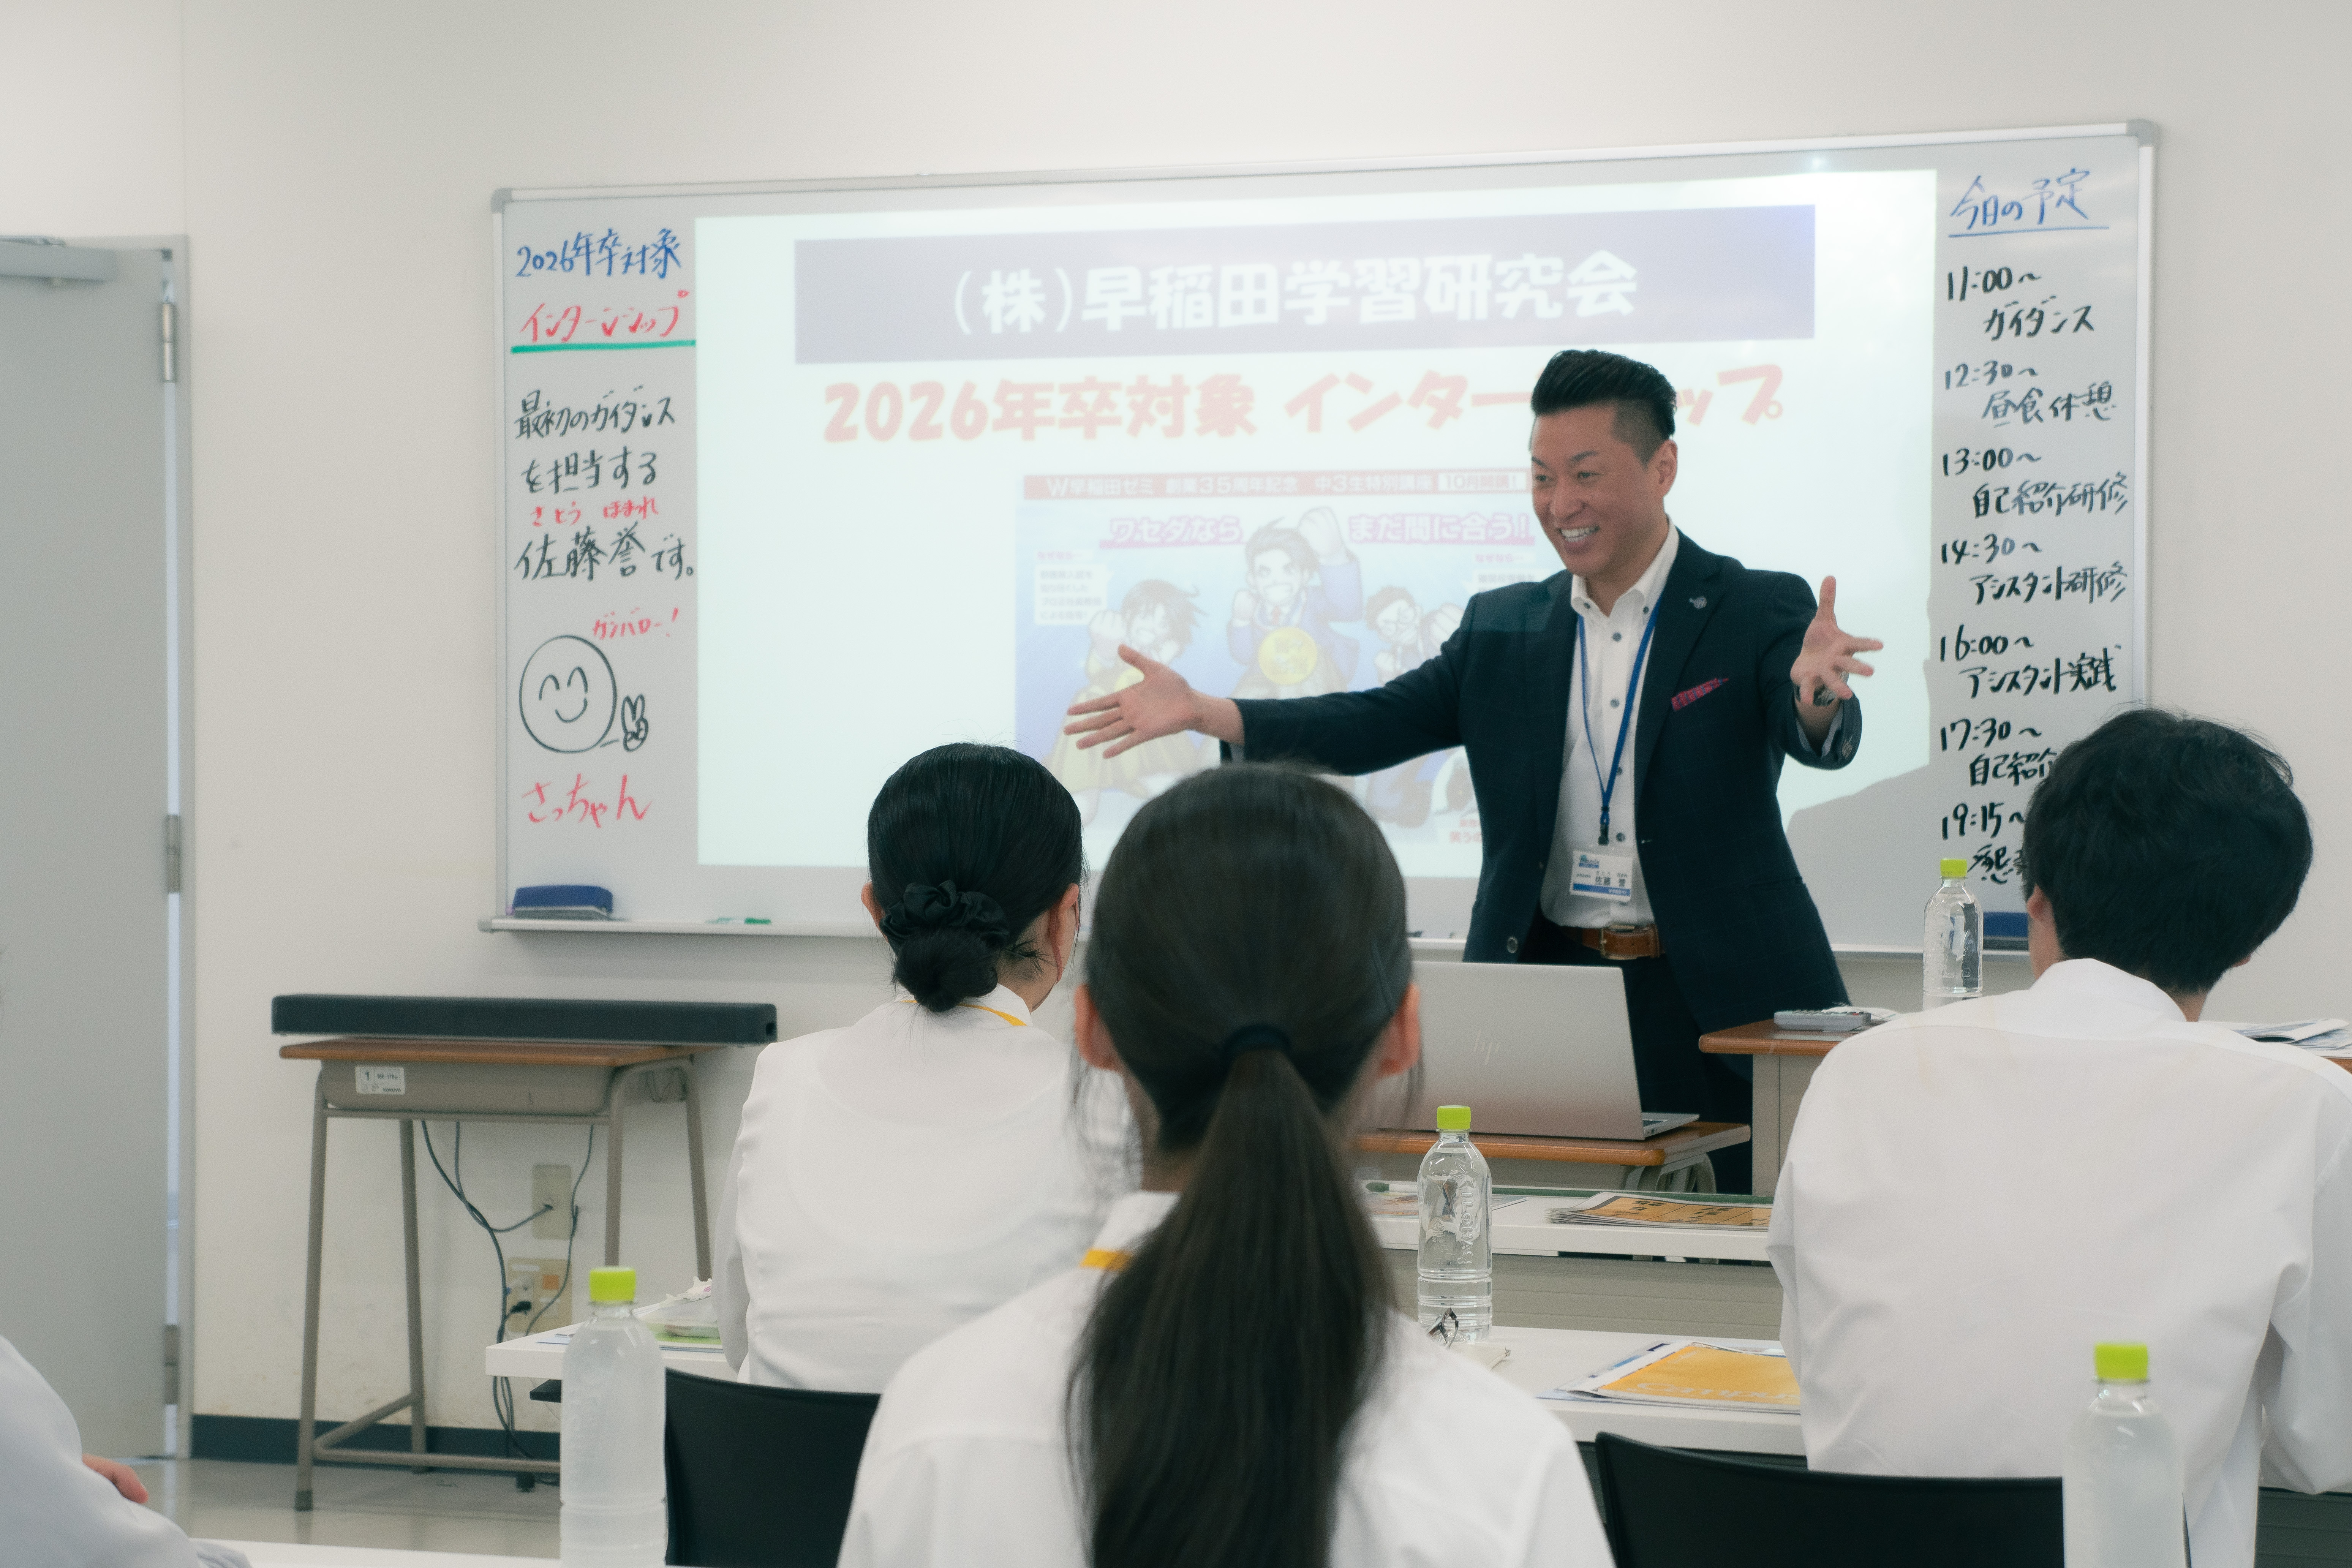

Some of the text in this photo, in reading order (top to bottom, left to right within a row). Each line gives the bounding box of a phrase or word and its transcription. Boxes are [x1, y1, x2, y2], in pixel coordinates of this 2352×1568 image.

[1949, 168, 2090, 230] 今日の予定
[515, 228, 681, 279] 2026年卒対象
[519, 289, 690, 343] インターンシップ
[954, 249, 1637, 335] (株)早稲田学習研究会
[1982, 295, 2095, 341] ガイダンス
[514, 384, 676, 440] 最初のガイダンス
[824, 373, 1257, 443] 2026年卒対象
[1981, 380, 2117, 428] 昼食休憩
[520, 446, 658, 495] を担当する
[1972, 471, 2128, 519] 自己紹介研修
[514, 521, 694, 582] 佐藤誉です。
[1111, 516, 1242, 544] ワセダなら
[1348, 512, 1529, 542] まだ間に合う!
[1969, 560, 2128, 606] アシスタント研修
[1957, 644, 2122, 699] アシスタント実践
[522, 773, 654, 828] さっちゃん
[1474, 1030, 1500, 1064] hp
